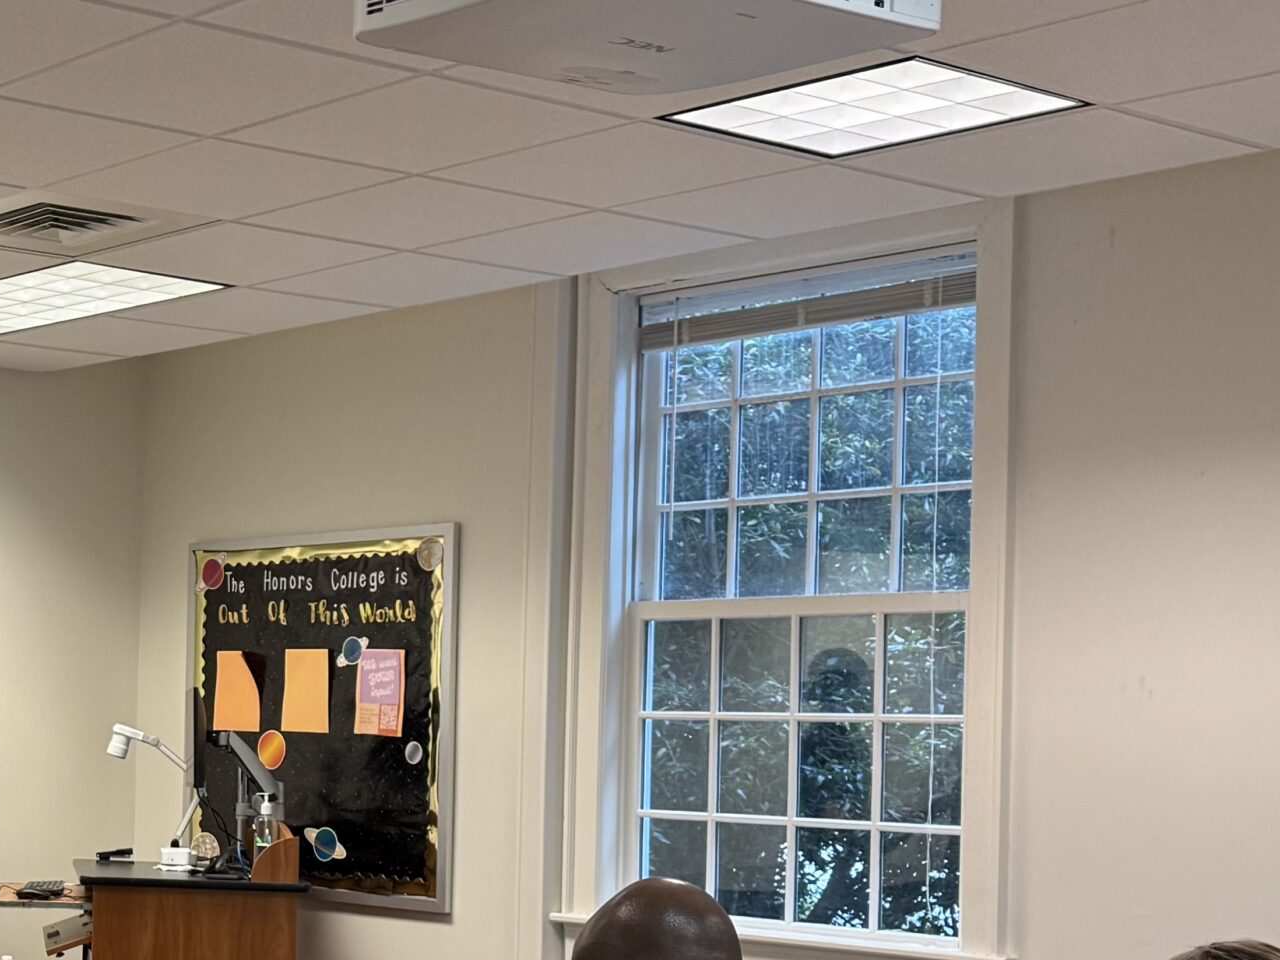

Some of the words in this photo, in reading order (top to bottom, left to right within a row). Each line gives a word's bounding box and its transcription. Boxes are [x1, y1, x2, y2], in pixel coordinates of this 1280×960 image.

[607, 36, 676, 53] NEC
[225, 571, 245, 594] The
[264, 570, 313, 591] Honors
[330, 568, 385, 592] College
[395, 567, 408, 586] is
[218, 603, 249, 625] Out
[268, 599, 287, 626] Of
[308, 599, 350, 627] This
[359, 599, 416, 624] World
